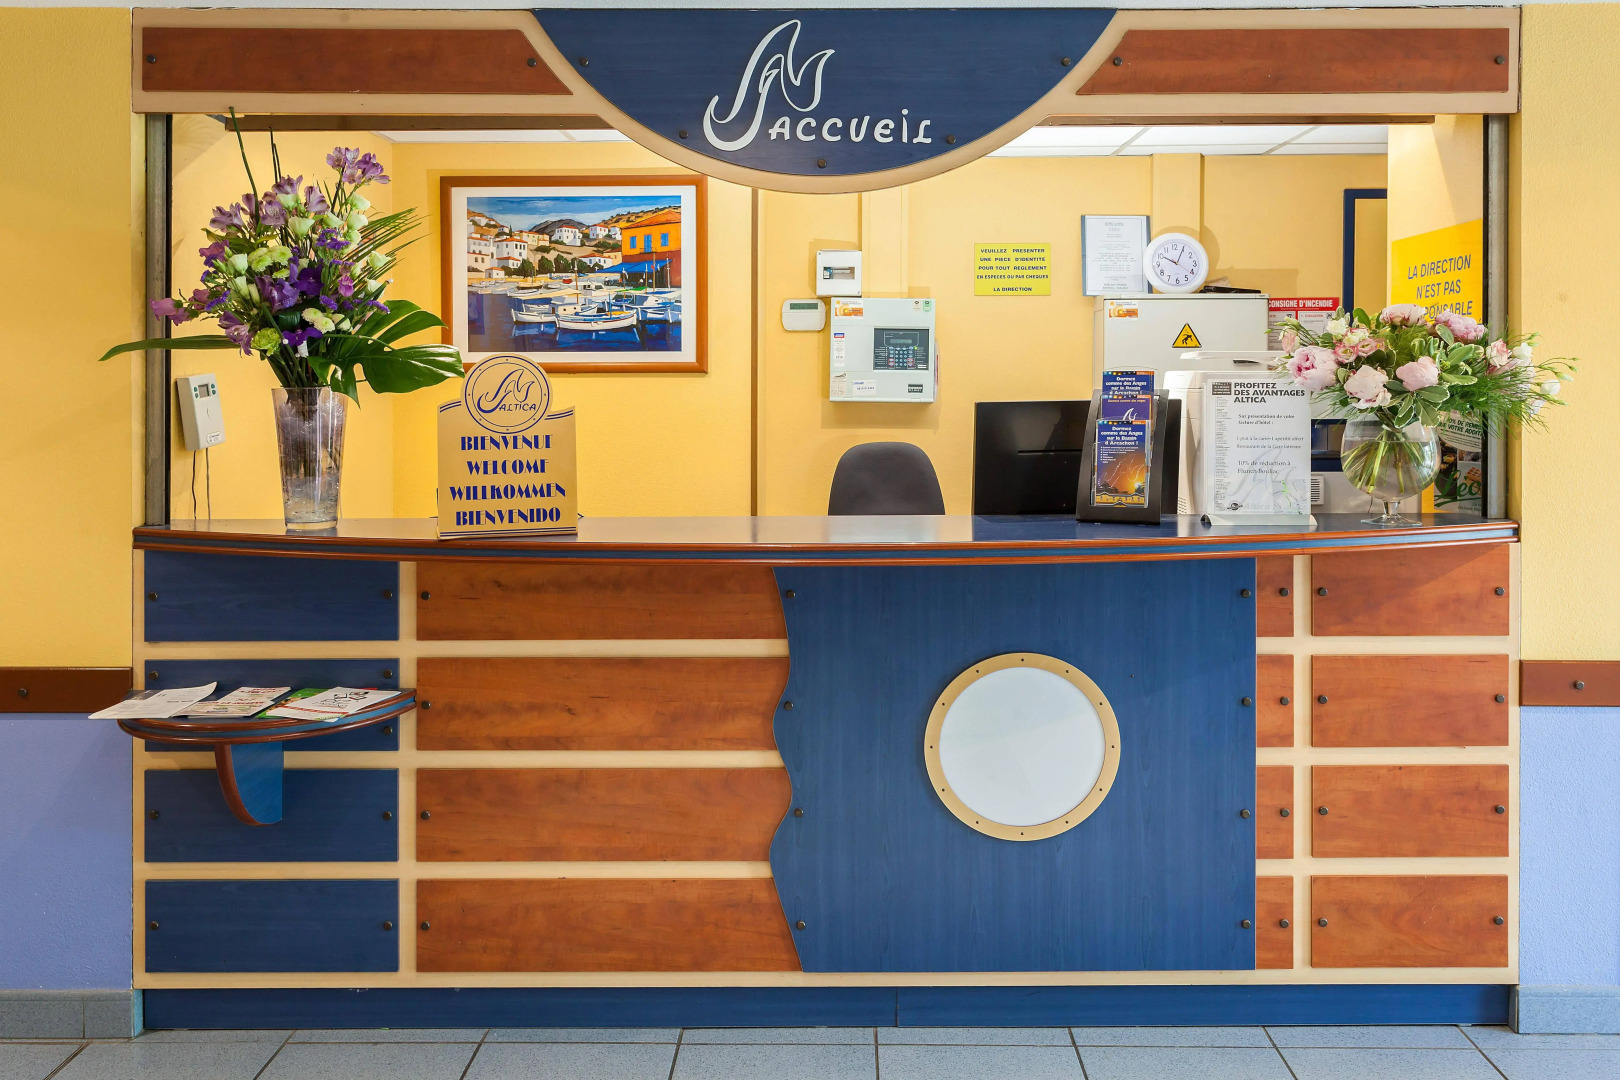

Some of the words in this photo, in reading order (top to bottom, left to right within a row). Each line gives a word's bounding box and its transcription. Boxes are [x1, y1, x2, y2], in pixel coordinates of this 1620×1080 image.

[1408, 265, 1418, 280] LA
[1420, 254, 1471, 278] DIRECTION
[1416, 282, 1441, 299] N'EST
[1444, 279, 1461, 295] PAS
[1422, 301, 1473, 319] PONSABLE
[499, 403, 537, 412] ALTICA
[1448, 424, 1464, 432] VOTRE
[460, 434, 553, 450] BIENVENUE
[467, 459, 549, 475] WELCOME
[449, 482, 566, 501] WILLKOMMEN
[456, 507, 561, 526] BIENVENIDO
